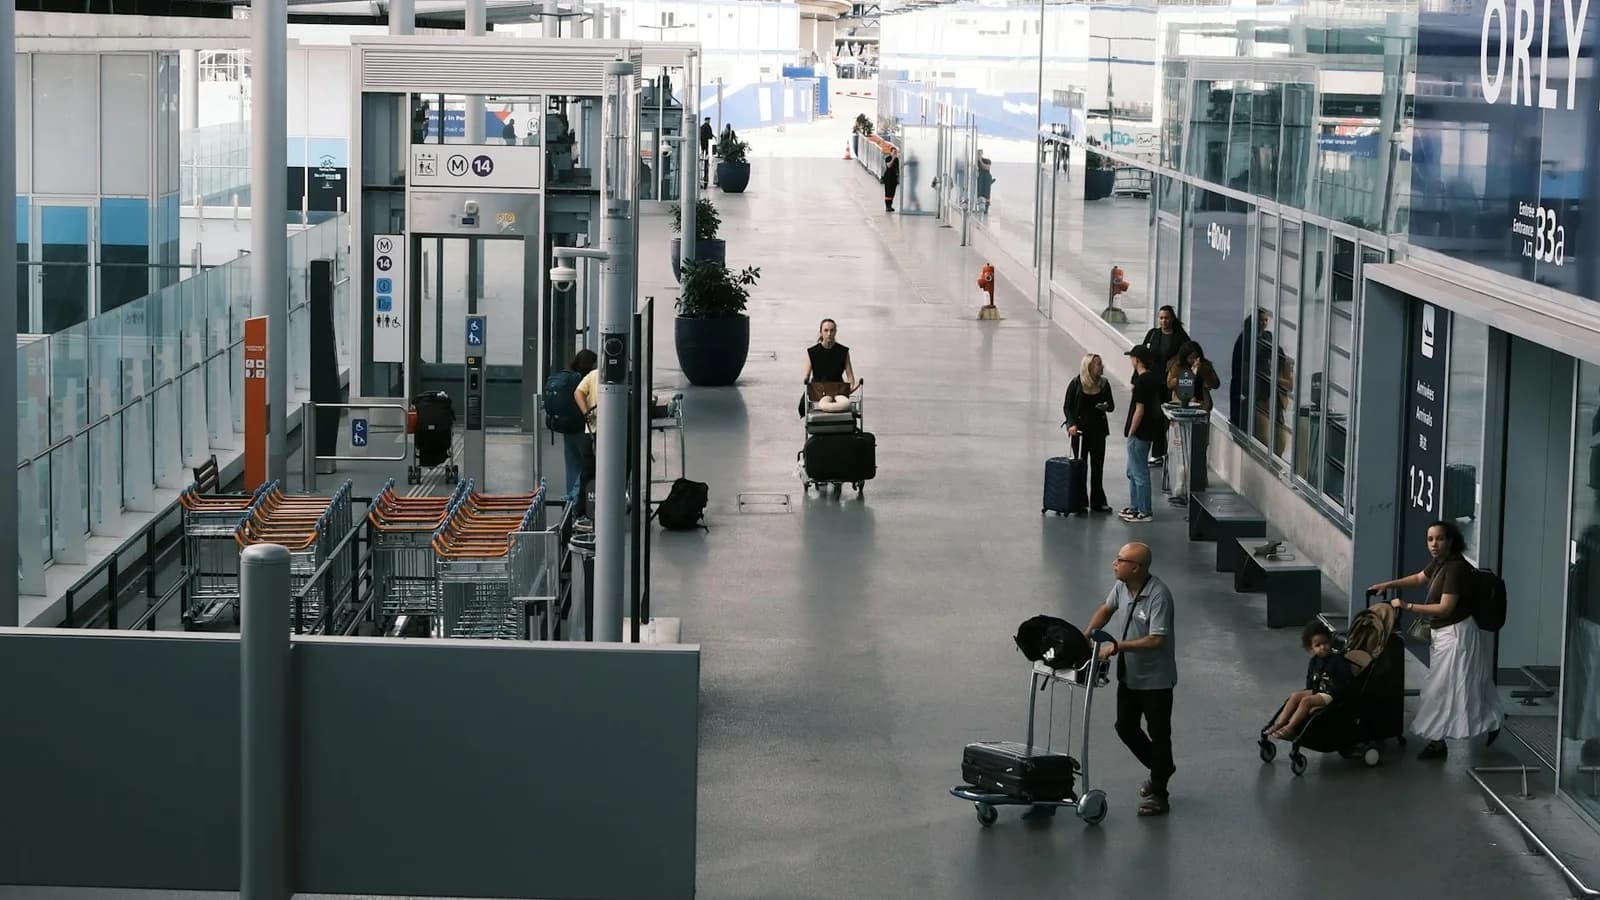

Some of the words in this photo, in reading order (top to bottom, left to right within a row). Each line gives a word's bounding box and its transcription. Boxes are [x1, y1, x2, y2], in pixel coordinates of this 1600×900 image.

[1480, 0, 1590, 110] ORLY
[450, 157, 465, 173] M
[474, 158, 492, 174] 14
[1519, 201, 1535, 218] Entrée
[1512, 218, 1534, 237] Entrance
[1535, 206, 1565, 267] B3a
[378, 258, 391, 269] 14
[1416, 379, 1434, 401] Arrivées
[1415, 405, 1433, 428] Arrivals
